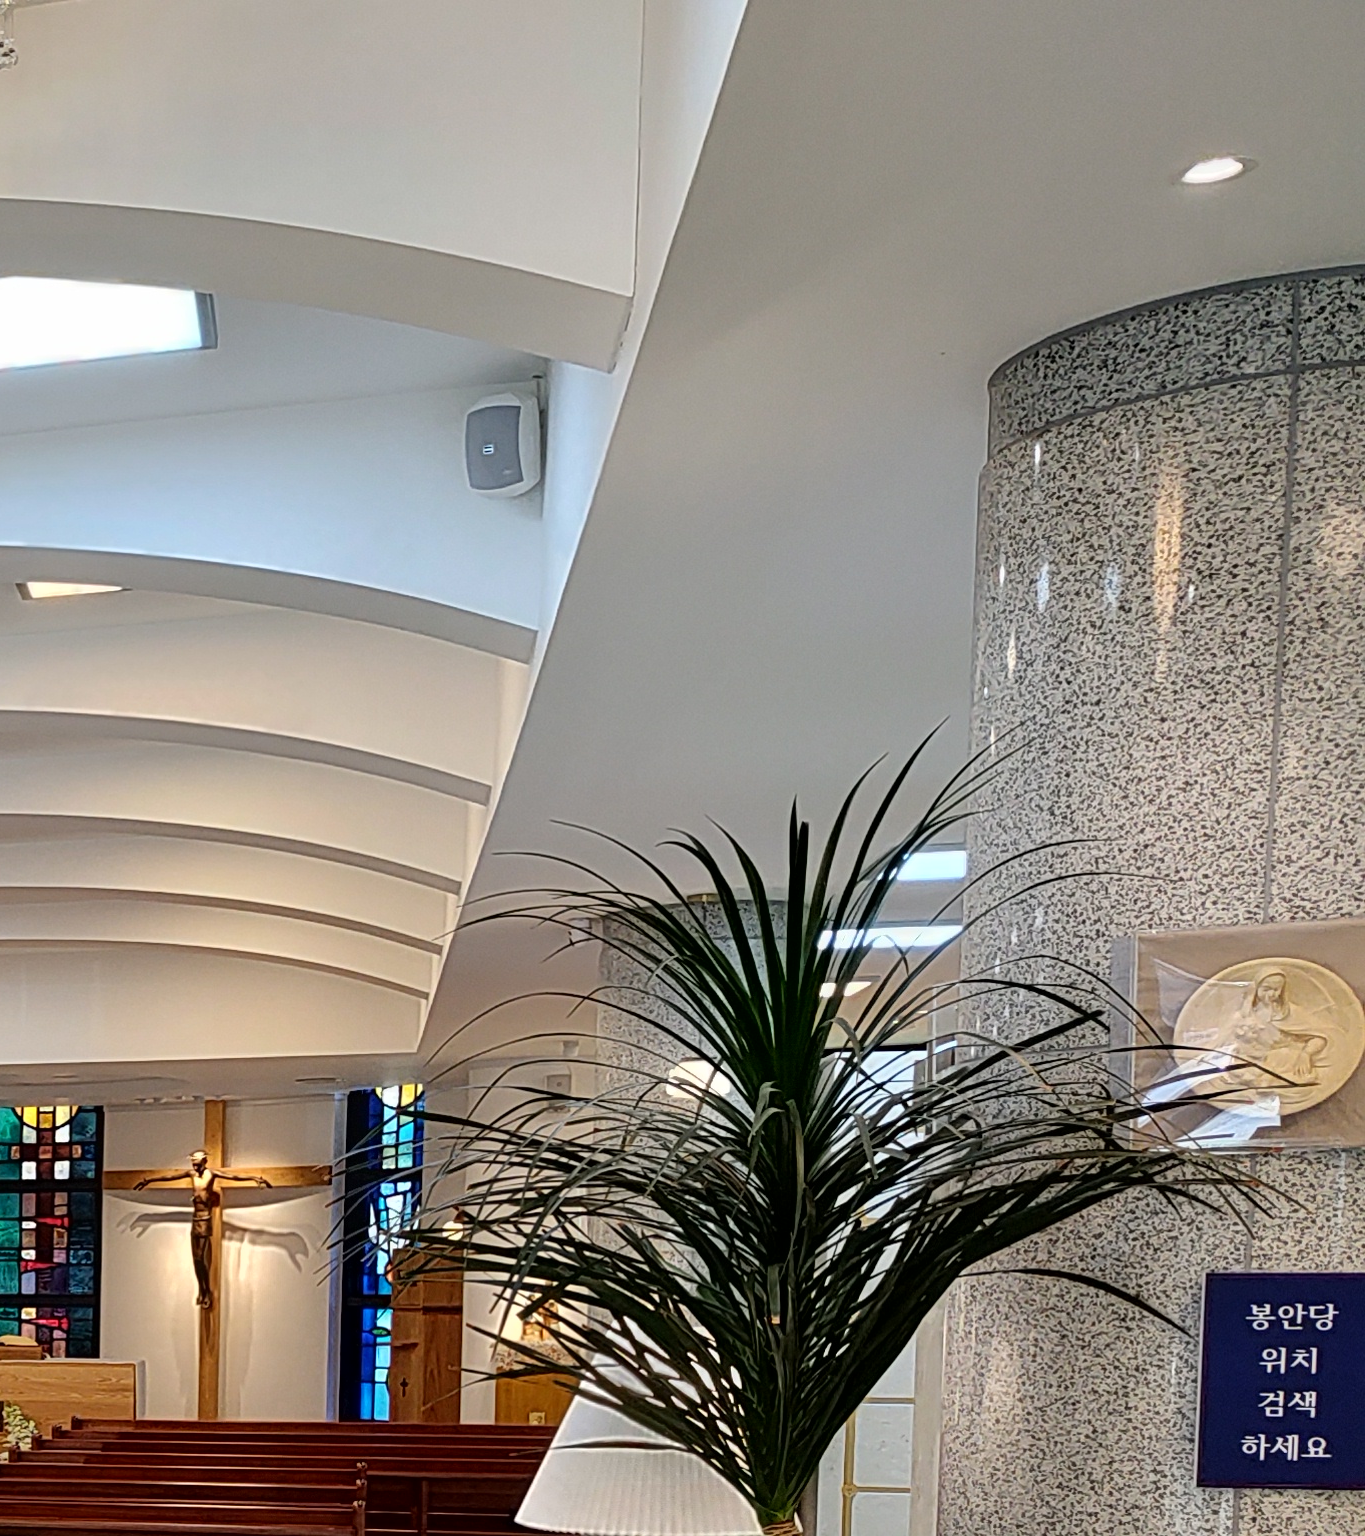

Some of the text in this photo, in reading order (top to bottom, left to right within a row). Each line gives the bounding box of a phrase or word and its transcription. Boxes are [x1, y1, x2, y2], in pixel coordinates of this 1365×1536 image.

[1244, 1302, 1340, 1332] 봉안당
[1258, 1346, 1319, 1375] 위치
[1257, 1389, 1318, 1419] 검색
[1240, 1433, 1333, 1462] 하세요
